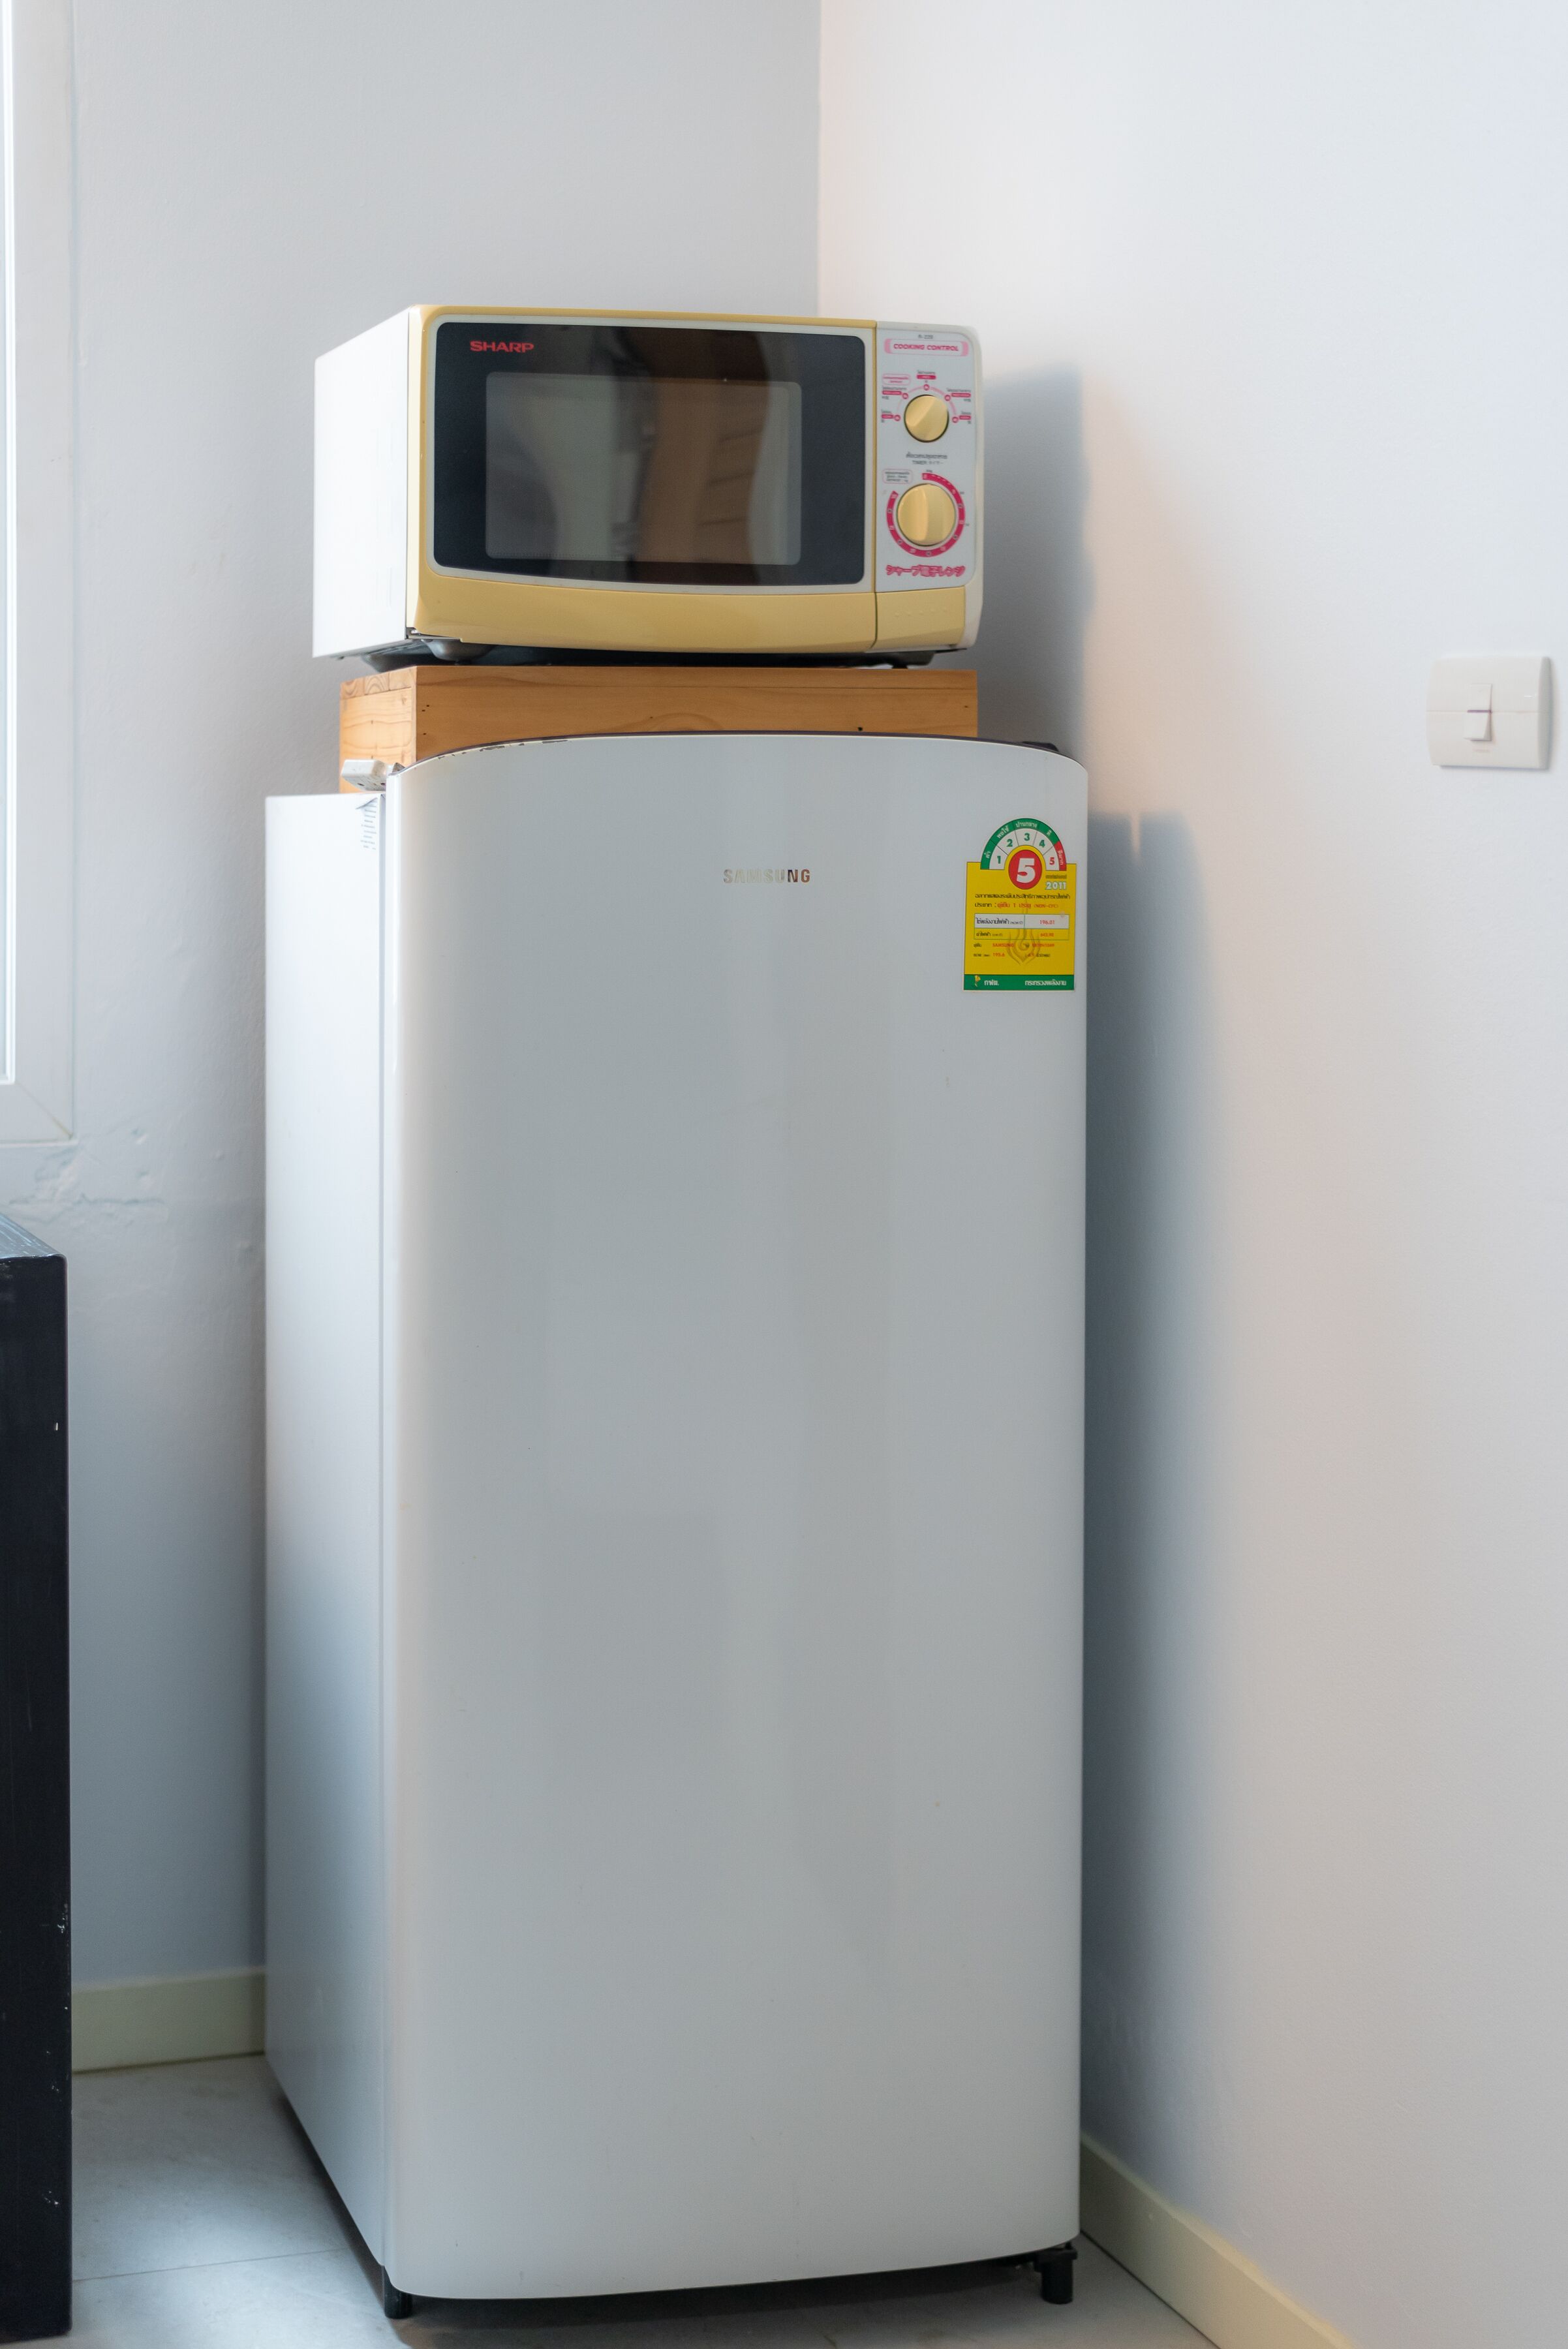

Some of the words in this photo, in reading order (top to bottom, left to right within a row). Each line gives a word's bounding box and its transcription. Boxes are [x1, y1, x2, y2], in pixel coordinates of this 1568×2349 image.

[470, 340, 534, 353] SHARP
[886, 564, 965, 577] シャープ電子レンジ
[996, 825, 1009, 839] พอใช้
[1024, 833, 1030, 841] 3
[997, 855, 1002, 864] 1
[1049, 857, 1055, 865] 5
[723, 869, 810, 883] SAMSUNG
[1016, 858, 1036, 883] 5
[1045, 882, 1067, 890] 2011
